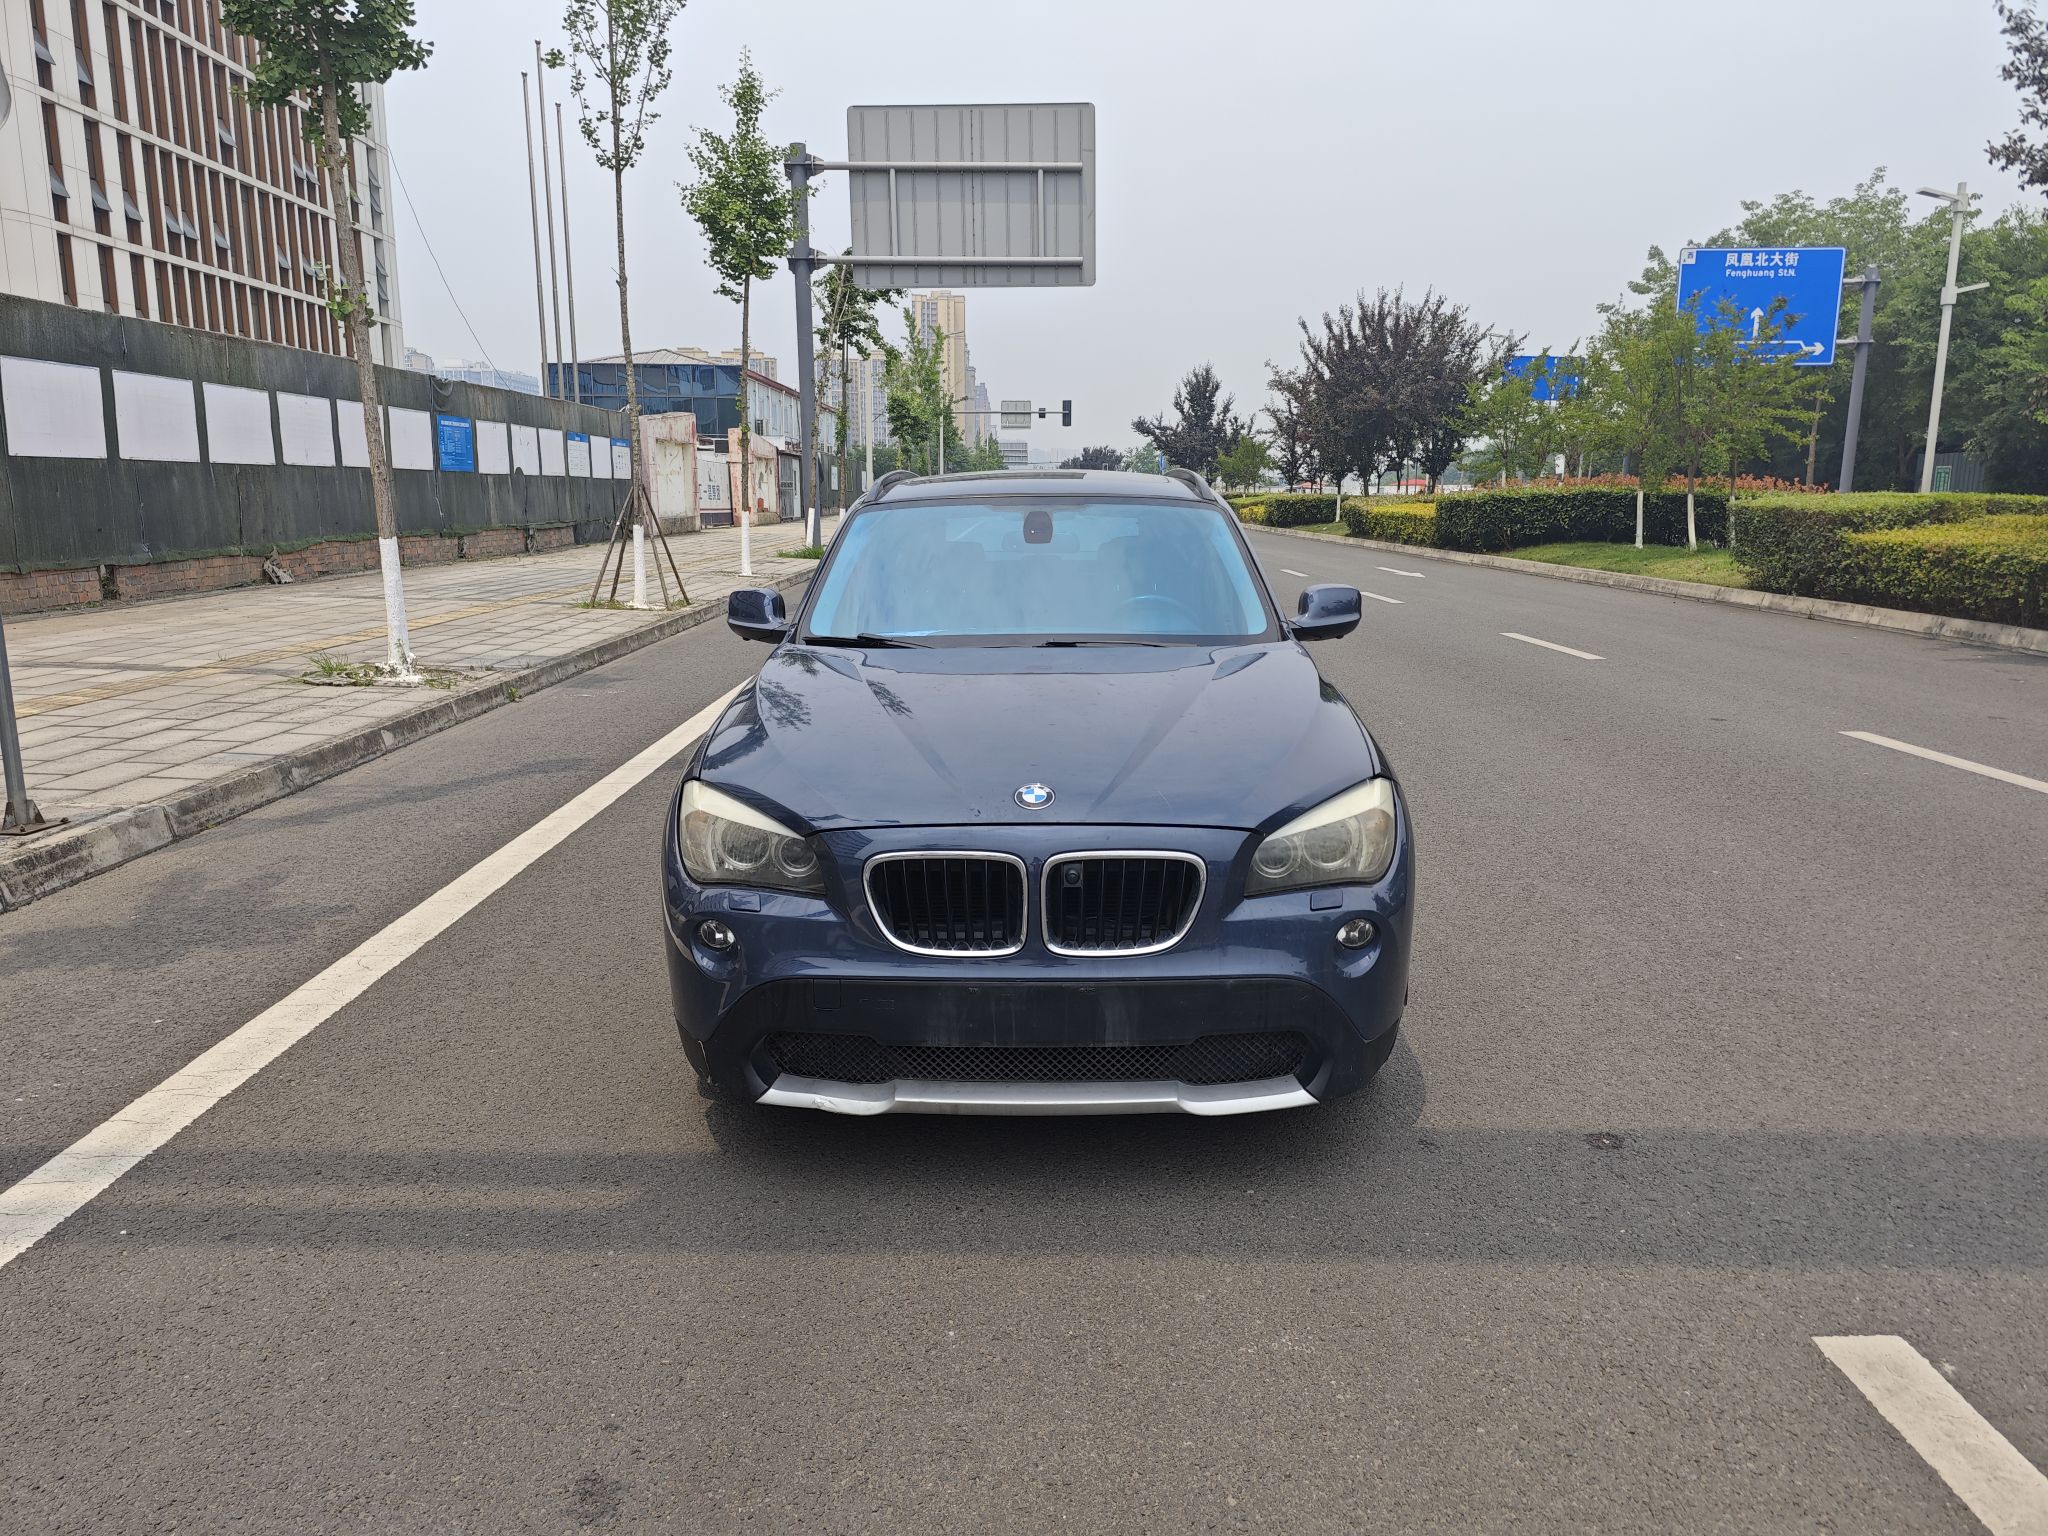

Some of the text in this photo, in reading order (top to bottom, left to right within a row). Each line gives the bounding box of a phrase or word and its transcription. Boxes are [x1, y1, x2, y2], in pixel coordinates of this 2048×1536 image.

[1725, 252, 1800, 267] 凤凰北大街
[1725, 269, 1775, 279] Fenghuang
